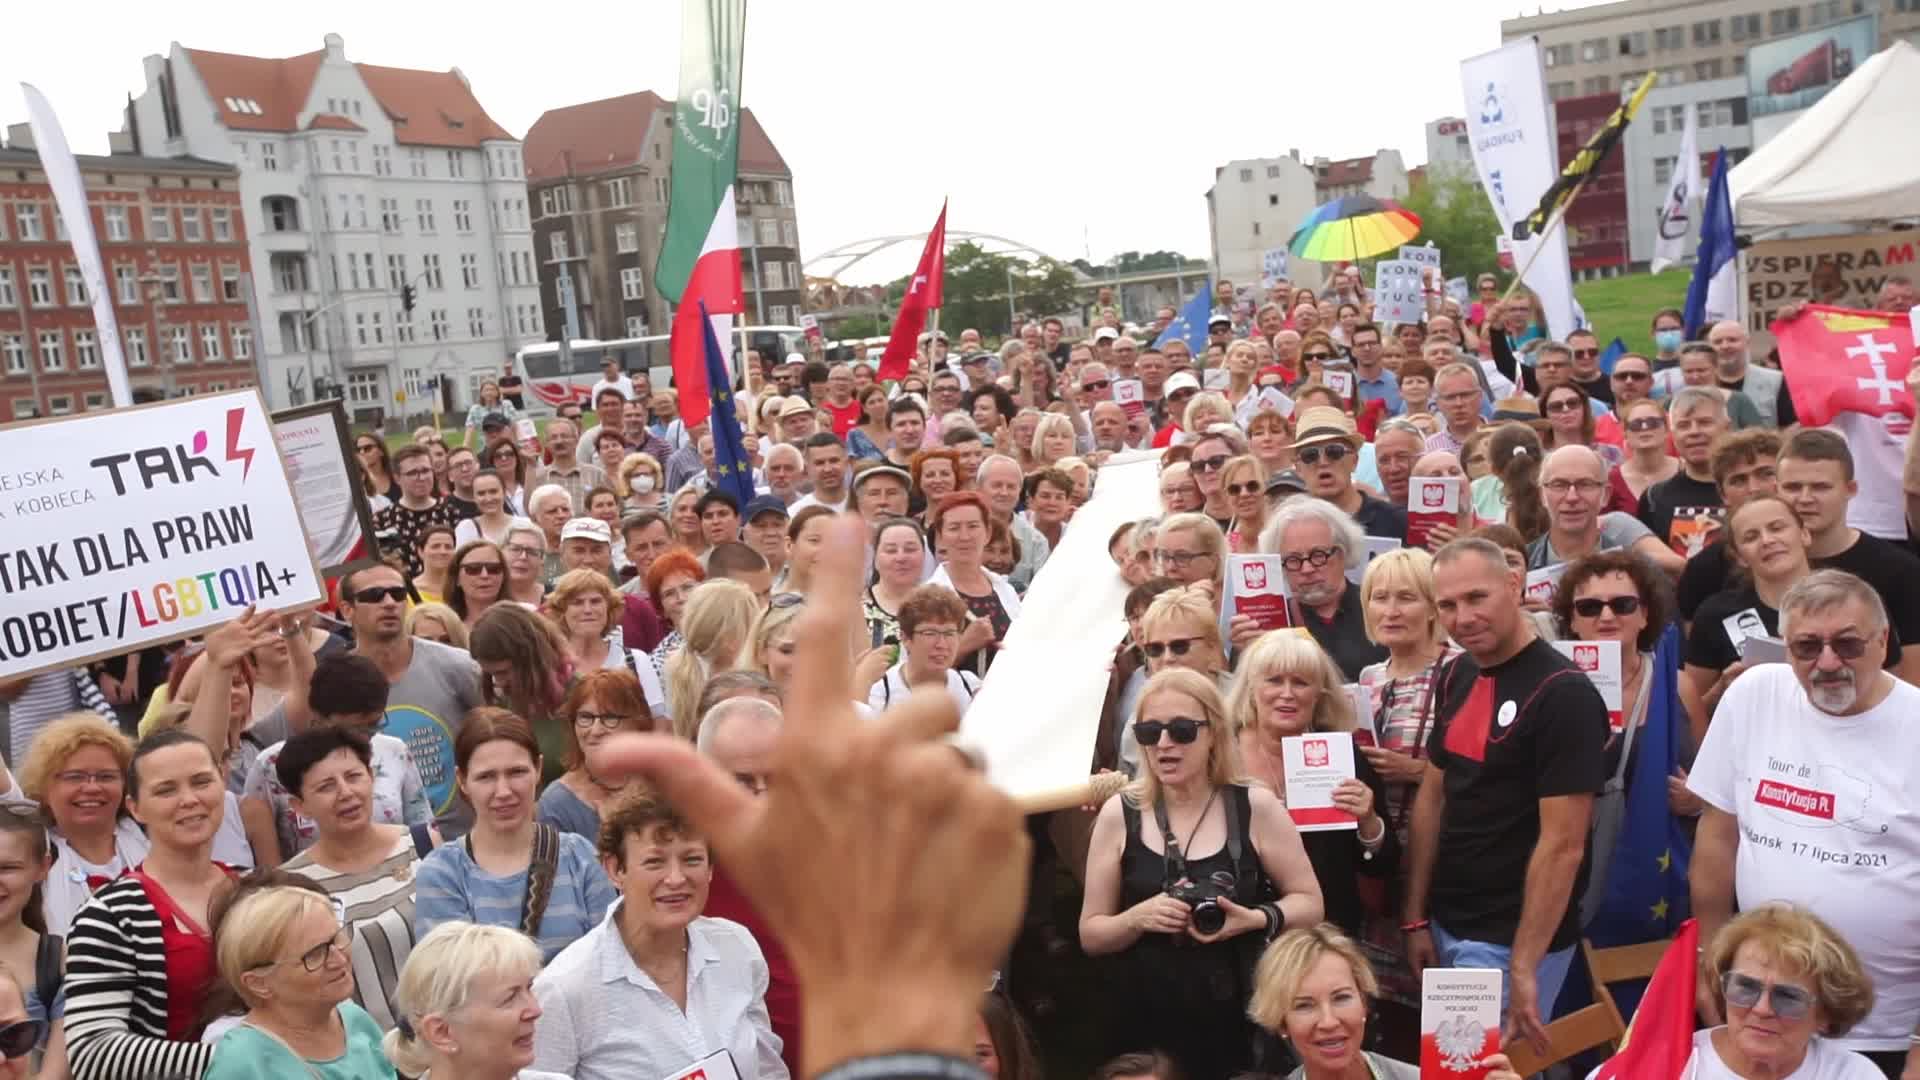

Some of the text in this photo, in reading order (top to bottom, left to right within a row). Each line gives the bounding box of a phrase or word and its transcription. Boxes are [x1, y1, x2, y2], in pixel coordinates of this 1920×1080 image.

[1381, 265, 1419, 276] KON
[0, 467, 64, 491] EJSKA
[90, 443, 220, 496] TAK
[14, 488, 96, 515] KOBIECA
[73, 527, 149, 577] DLA
[152, 504, 254, 560] PRAW
[0, 561, 297, 662] OBIET/LGBTQIA+
[1767, 756, 1811, 778] Tour de
[1760, 782, 1818, 813] Konstytucja
[1791, 842, 1808, 857] 17
[1812, 847, 1849, 865] lipca
[1854, 852, 1888, 867] 2021
